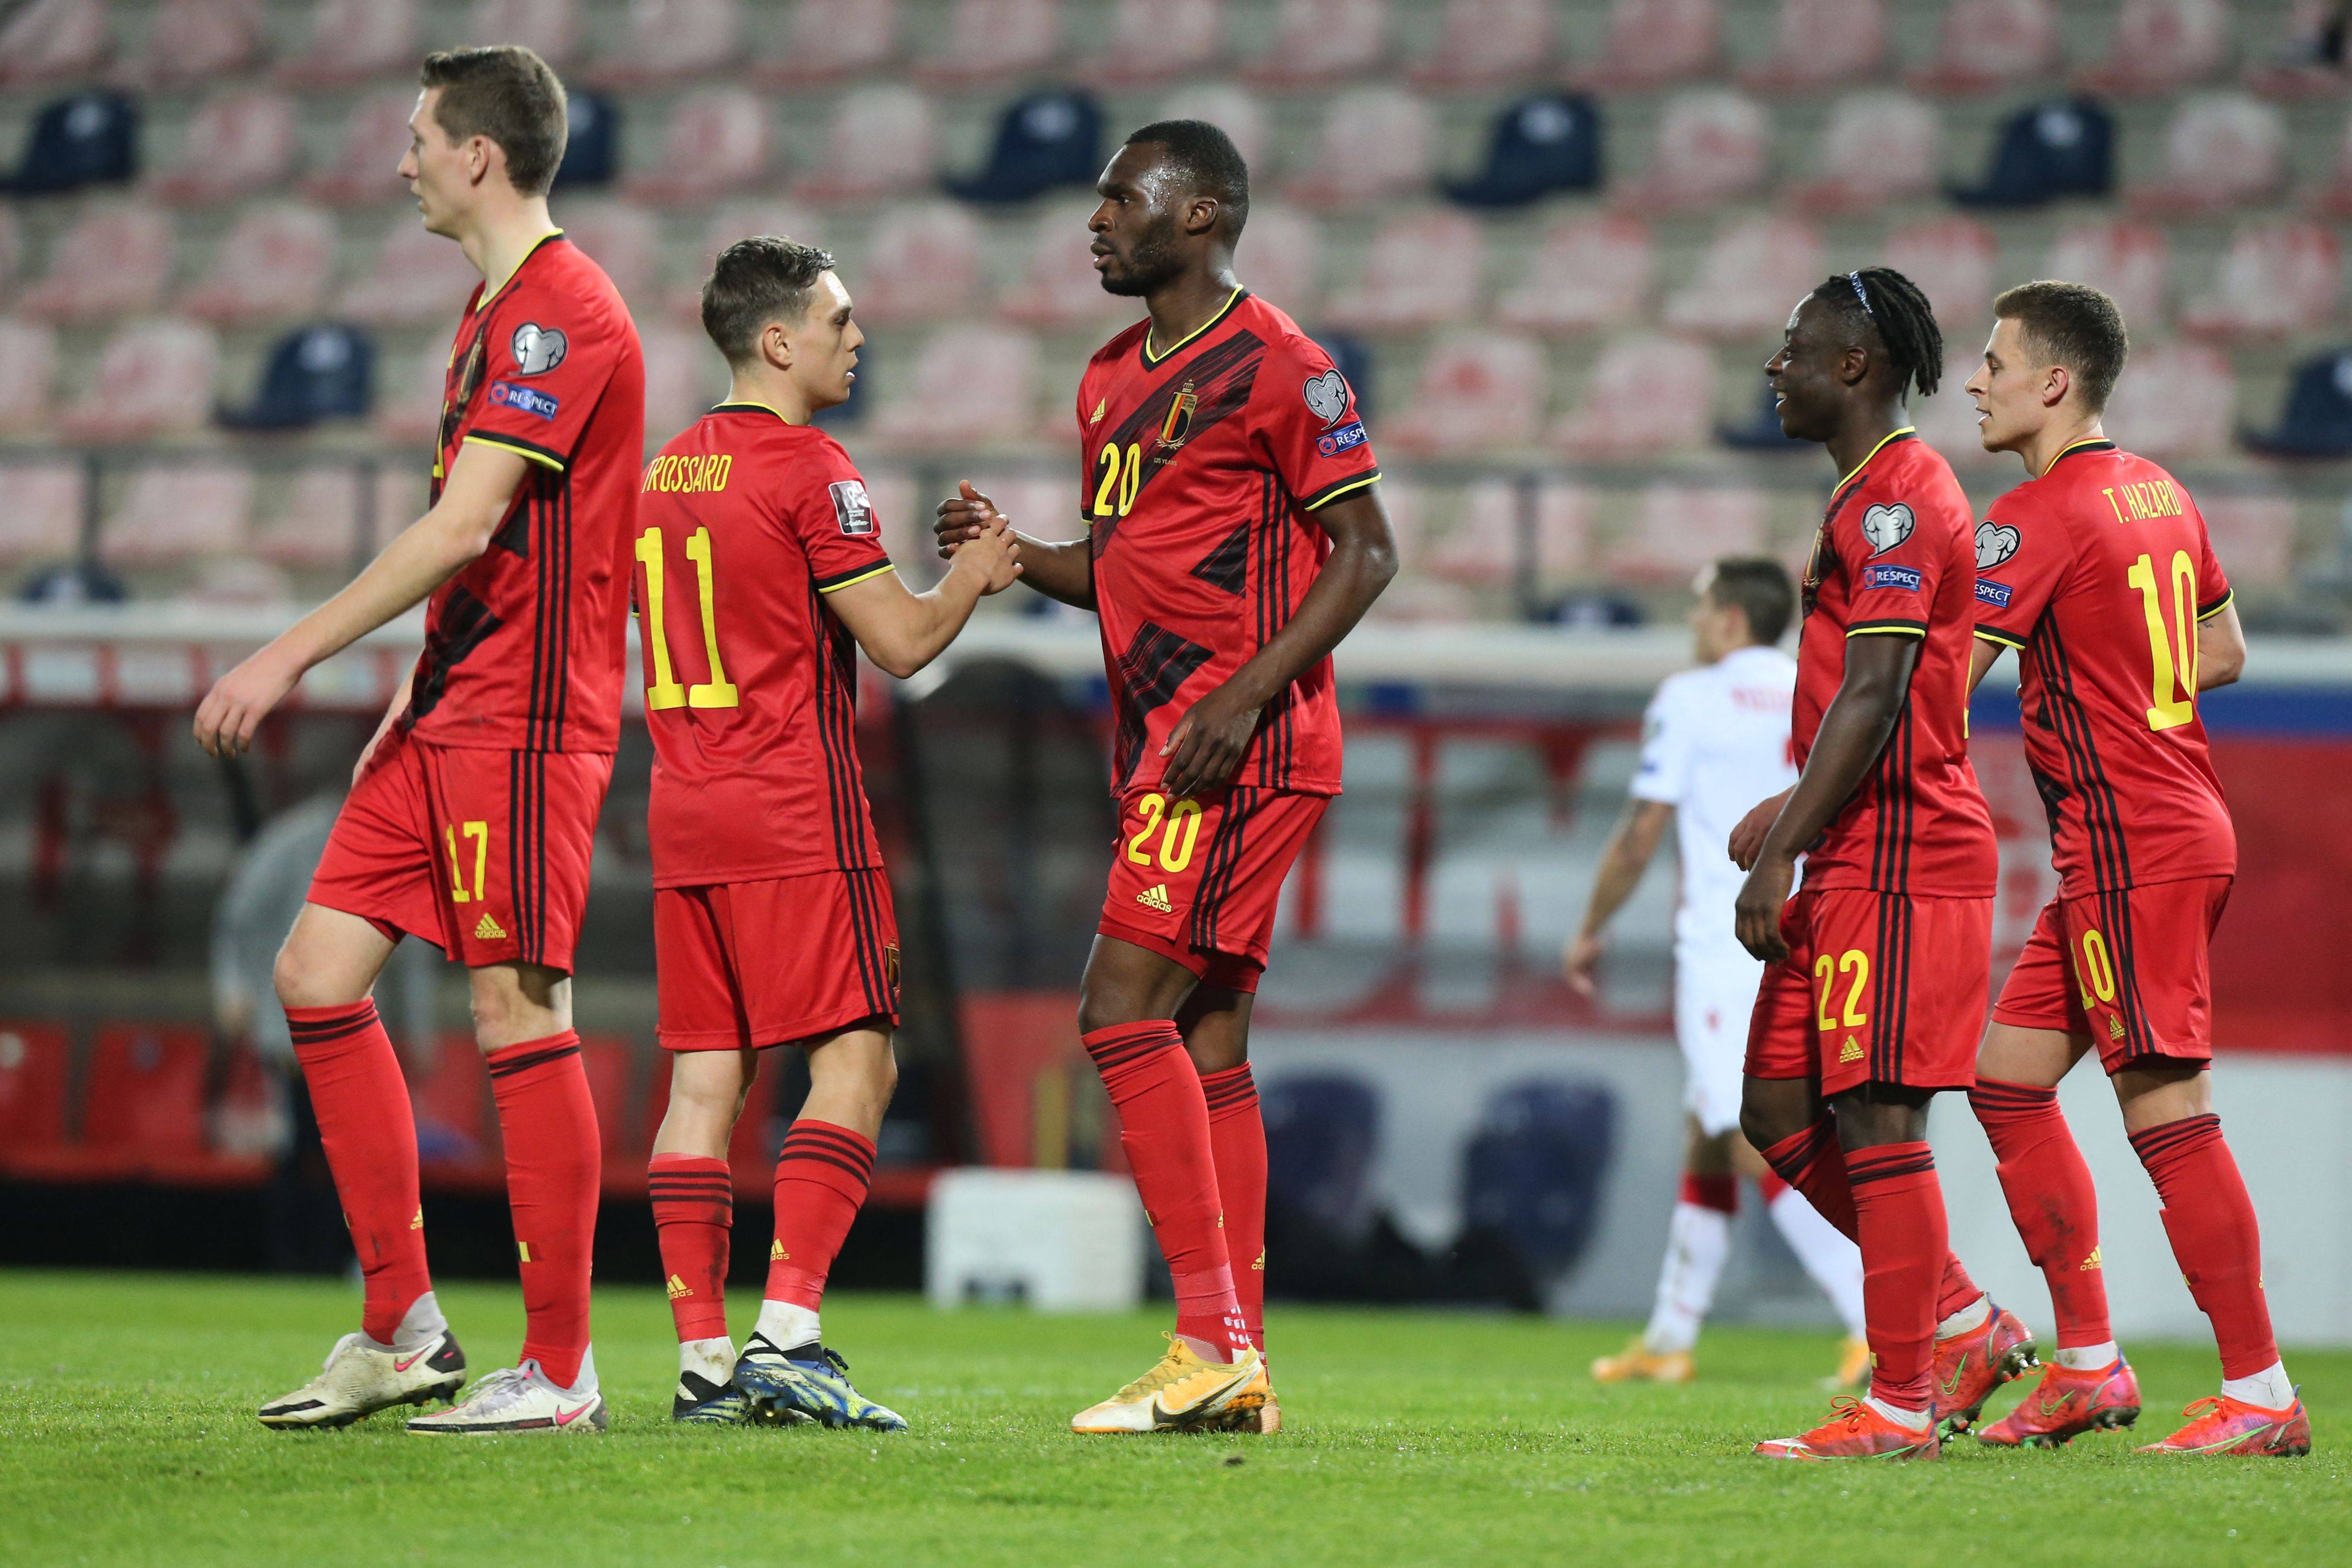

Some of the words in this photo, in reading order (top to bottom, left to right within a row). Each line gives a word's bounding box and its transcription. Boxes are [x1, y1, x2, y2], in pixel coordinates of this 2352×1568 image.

[509, 390, 557, 414] RESPECT
[1336, 426, 1367, 446] RESPE
[641, 454, 732, 494] TROSSARD
[1094, 442, 1140, 517] 20
[2102, 487, 2130, 524] T.
[2120, 480, 2182, 520] HAZARD
[1876, 571, 1920, 585] RESPECT
[1974, 584, 2011, 602] ESPECT
[635, 526, 739, 711] 11
[2127, 550, 2197, 731] 10
[1128, 793, 1203, 873] 20
[446, 821, 488, 903] 17
[1136, 894, 1172, 913] adidas
[475, 929, 506, 939] adidas
[1815, 949, 1869, 1031] 22
[2070, 929, 2115, 1011] 10
[1839, 1050, 1865, 1063] adidas
[2080, 1261, 2101, 1271] adid
